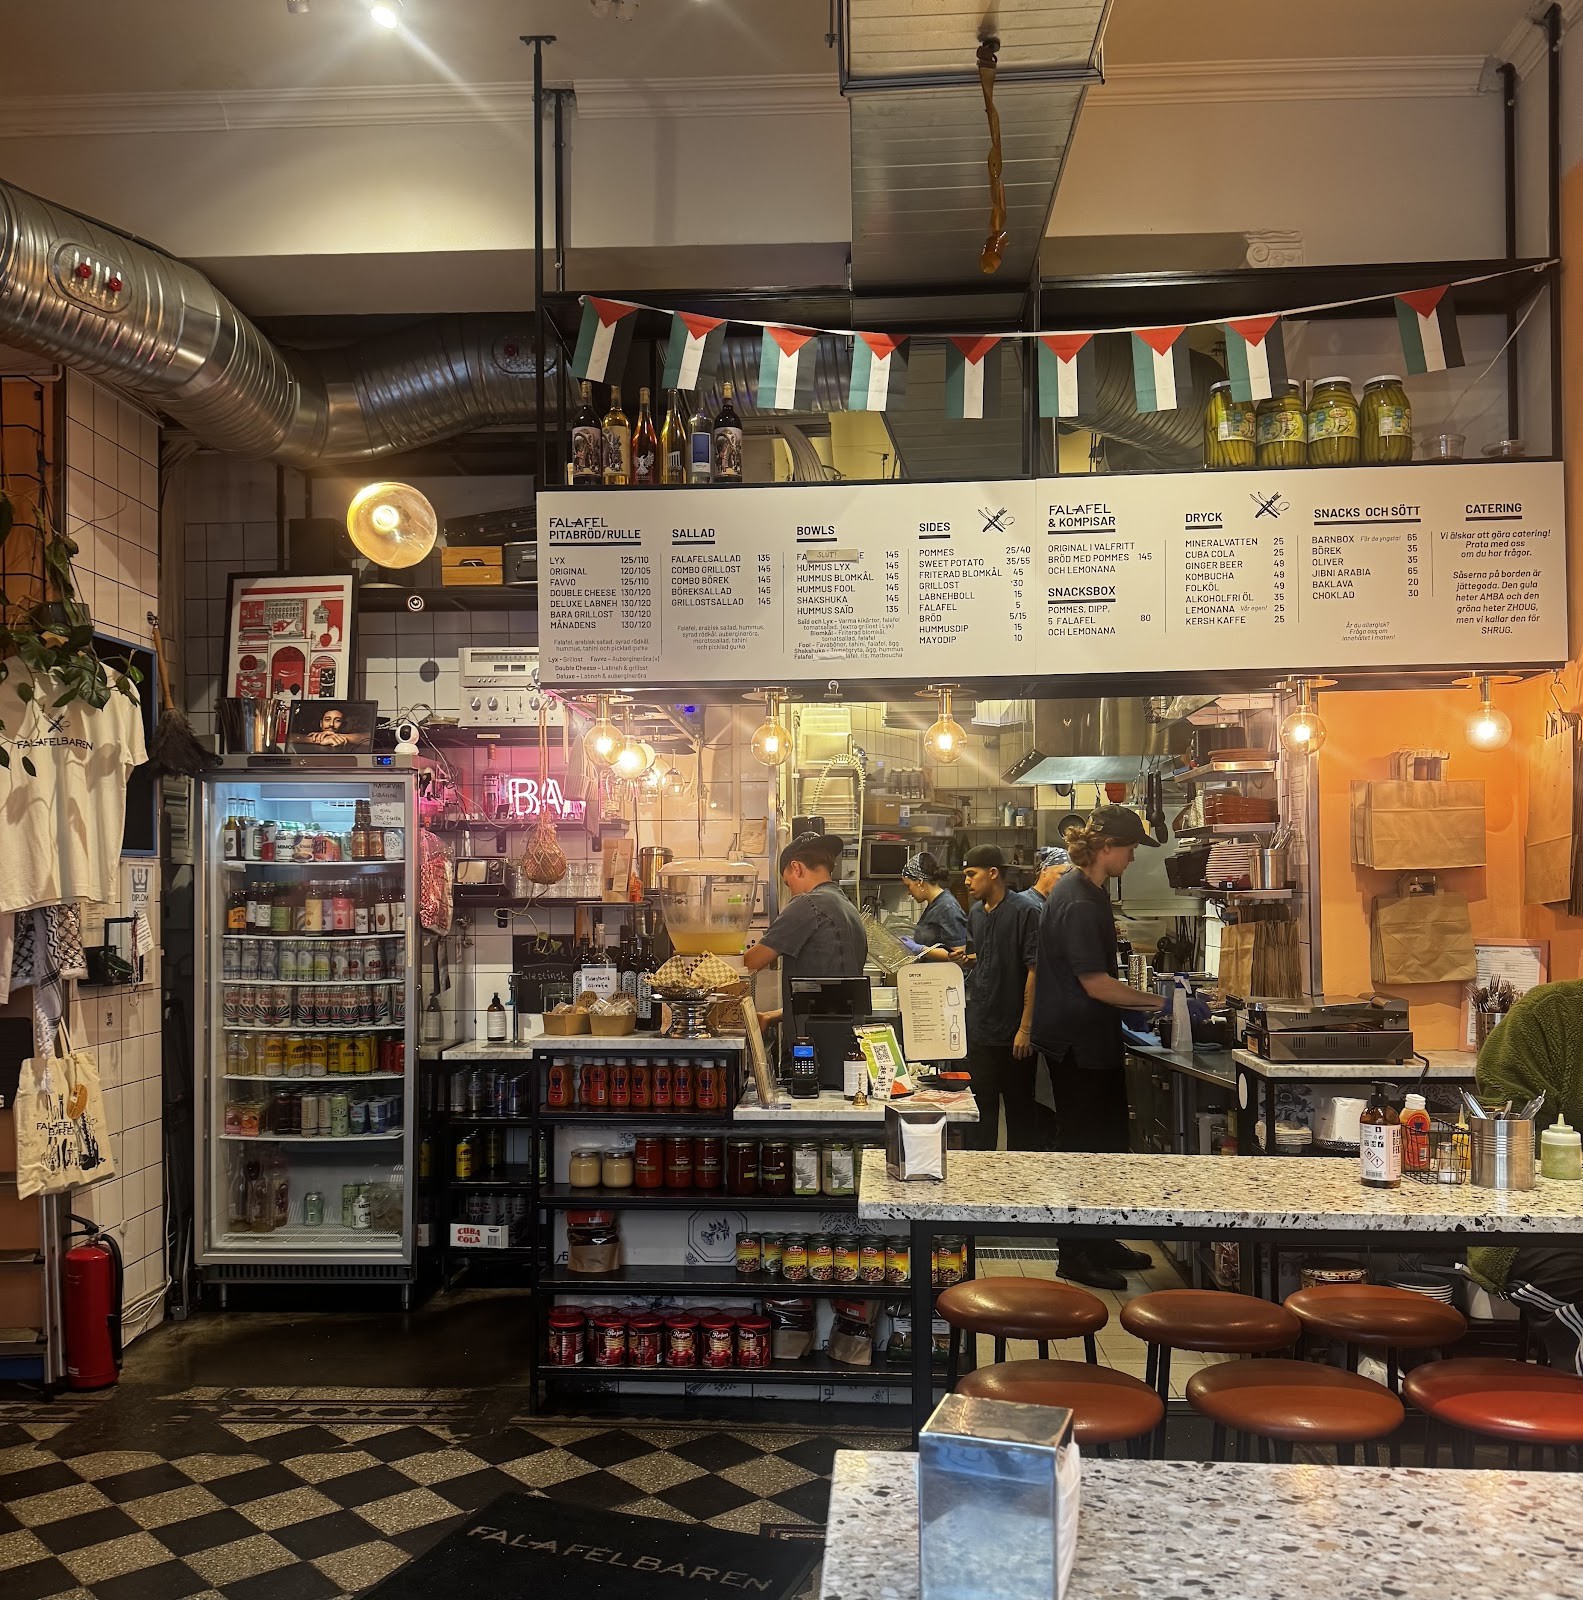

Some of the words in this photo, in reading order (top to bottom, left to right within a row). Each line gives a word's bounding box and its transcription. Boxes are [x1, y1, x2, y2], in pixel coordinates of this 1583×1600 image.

[1049, 504, 1111, 515] FALAFEL
[1314, 508, 1360, 518] SNACKS
[1366, 507, 1388, 517] OCH
[1391, 504, 1420, 516] SÖTT
[1466, 503, 1522, 514] CATERING
[1048, 518, 1056, 528] &
[1059, 516, 1116, 527] KOMPISAR
[1186, 512, 1222, 522] DRYCK
[550, 517, 608, 528] FALAFEL
[919, 522, 950, 532] SIDES
[550, 528, 641, 539] PITABRÖD/RULLE
[672, 528, 715, 538] SALLAD
[797, 526, 835, 535] BOWLS
[1440, 532, 1448, 540] Vi
[1477, 531, 1490, 539] att
[1491, 530, 1510, 540] göra
[1512, 529, 1551, 539] catering!
[1185, 538, 1258, 548] MINERALVATTEN
[1312, 535, 1354, 544] BARNBOX
[1490, 540, 1509, 548] med
[919, 549, 954, 557] POMMES
[1006, 546, 1031, 554] 25/40
[1048, 544, 1088, 553] ORIGINAL
[1094, 542, 1135, 551] VALFRITT
[1312, 546, 1342, 555] BÖREK
[1048, 553, 1071, 563] BRÖD
[1073, 555, 1091, 563] MED
[1093, 553, 1129, 562] POMMES
[1138, 552, 1152, 560] 145
[1185, 551, 1209, 559] CUBA
[1211, 550, 1235, 558] COLA
[1476, 550, 1487, 558] du
[1488, 549, 1502, 557] har
[1504, 548, 1532, 558] frågor.
[549, 557, 565, 565] LYX
[621, 556, 649, 564] 125/110
[671, 555, 741, 563] FALAFELSALLAD
[758, 554, 770, 562] 135
[919, 559, 949, 568] SWEET
[950, 558, 984, 567] POTATO
[1006, 557, 1030, 565] 35/55
[1312, 558, 1344, 566] OLIVER
[671, 566, 700, 574] COMBO
[701, 565, 741, 574] GRILLOST
[796, 563, 832, 572] HUMMUS
[834, 563, 850, 571] LYX
[886, 561, 899, 569] 145
[1048, 567, 1065, 575] OCH
[1067, 565, 1116, 574] LEMONANA
[1185, 561, 1218, 570] GINGER
[1220, 560, 1243, 569] BEER
[621, 567, 651, 575] 120/105
[919, 570, 960, 579] FRITERAD
[962, 566, 1002, 578] BLOMKÅL
[1312, 569, 1335, 577] JIBNI
[1337, 568, 1371, 576] ARABIA
[1453, 570, 1487, 579] Såserna
[1489, 569, 1500, 580] på
[1501, 570, 1531, 578] borden
[1532, 569, 1542, 577] är
[671, 577, 700, 585] COMBO
[702, 575, 729, 584] BÖREK
[797, 574, 832, 582] HUMMUS
[834, 571, 874, 582] BLOMKÅL
[886, 572, 899, 580] 145
[1185, 572, 1234, 581] KOMBUCHA
[550, 578, 576, 586] FAVVO
[919, 581, 959, 590] GRILLOST
[1185, 582, 1219, 592] FOLKÖL
[1312, 580, 1353, 588] BAKLAVA
[1456, 582, 1499, 592] jättegoda.
[1502, 581, 1518, 589] Den
[1520, 580, 1538, 590] gula
[550, 589, 583, 597] DOUBLE
[584, 589, 616, 597] CHEESE
[621, 588, 651, 596] 130/120
[671, 586, 732, 596] BÖREKSALLAD
[758, 586, 771, 594] 145
[797, 585, 832, 593] HUMMUS
[886, 583, 899, 591] 145
[1048, 586, 1115, 597] SNACKSBOX
[797, 596, 848, 604] SHAKSHUKA
[886, 594, 899, 602] 145
[919, 592, 975, 601] LABNEHBOLL
[1185, 594, 1240, 603] ALKOHOLFRI
[1242, 591, 1254, 601] ÖL
[1312, 591, 1355, 600] CHOKLAD
[1479, 593, 1504, 601] AMBA
[1506, 592, 1522, 600] och
[1523, 592, 1539, 600] den
[550, 600, 582, 608] DELUXE
[621, 599, 651, 607] 130/120
[671, 598, 744, 607] GRILLOSTSALLAD
[758, 597, 771, 605] 145
[919, 603, 957, 611] FALAFEL
[797, 607, 832, 615] HUMMUS
[886, 605, 899, 613] 135
[1048, 605, 1086, 614] POMMES,
[1088, 605, 1110, 613] DIPP,
[1186, 605, 1235, 614] LEMONANA
[1457, 604, 1481, 614] gröna
[1483, 604, 1506, 612] heter
[1507, 603, 1538, 611] ZHOUG,
[574, 610, 614, 618] GRILLOST
[621, 610, 651, 618] 130/120
[919, 613, 942, 622] BRÖD
[1476, 615, 1484, 623] vi
[1485, 615, 1509, 623] kallar
[1528, 614, 1540, 622] för
[550, 619, 596, 629] MÅNADENS
[621, 621, 651, 629] 130/120
[1048, 617, 1053, 625] 5
[1057, 616, 1096, 625] FALAFEL
[1186, 617, 1215, 625] KERSH
[1217, 616, 1246, 624] KAFFE
[919, 625, 969, 633] HUMMUSDIP
[1048, 628, 1065, 636] OCH
[1067, 627, 1116, 635] LEMONANA
[1481, 626, 1513, 634] SHRUG.
[919, 636, 957, 644] MAYODIP
[457, 1228, 480, 1236] CUBA
